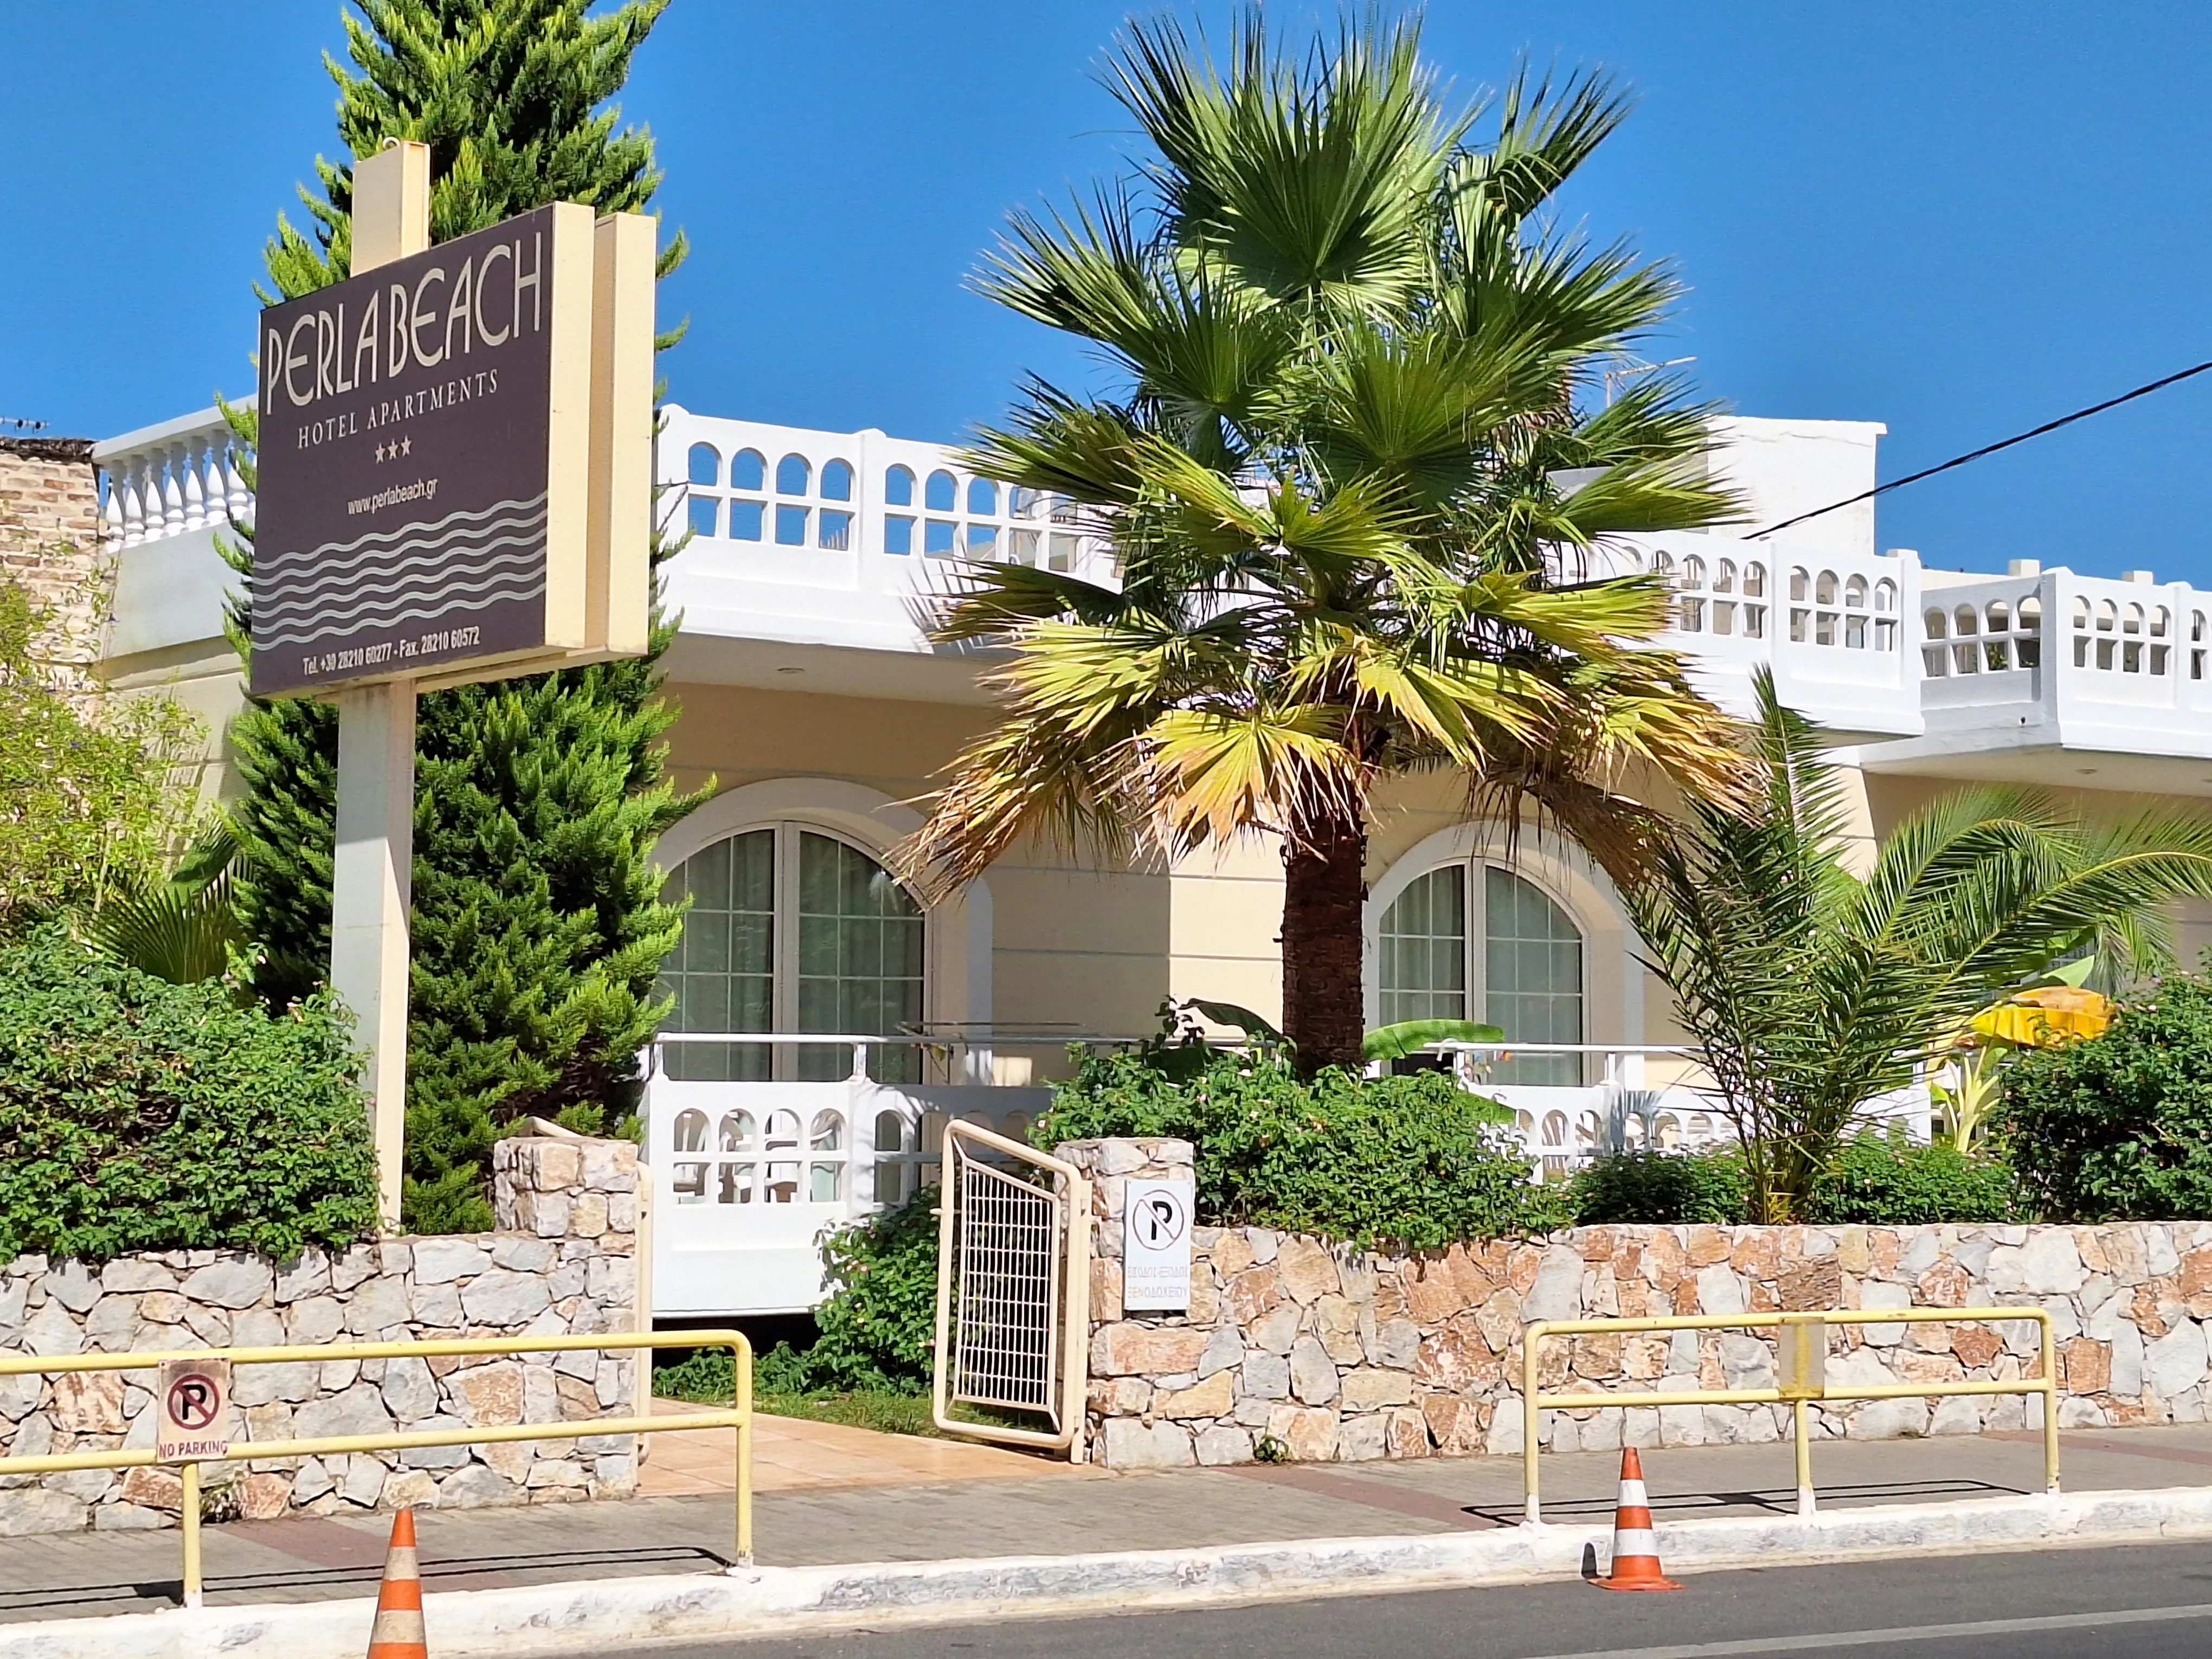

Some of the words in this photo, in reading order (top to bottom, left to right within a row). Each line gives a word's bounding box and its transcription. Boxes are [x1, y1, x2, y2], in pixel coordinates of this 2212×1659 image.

[298, 412, 358, 449] HOTEL
[367, 369, 498, 430] APARTMENTS
[347, 478, 438, 515] www.perlabeach.gr
[320, 653, 336, 672] +30
[338, 647, 364, 669] 28210
[365, 642, 393, 665] 60277
[421, 631, 449, 654] 28210
[451, 626, 480, 649] 60572
[159, 1443, 175, 1458] NO
[178, 1440, 228, 1456] PARKING
